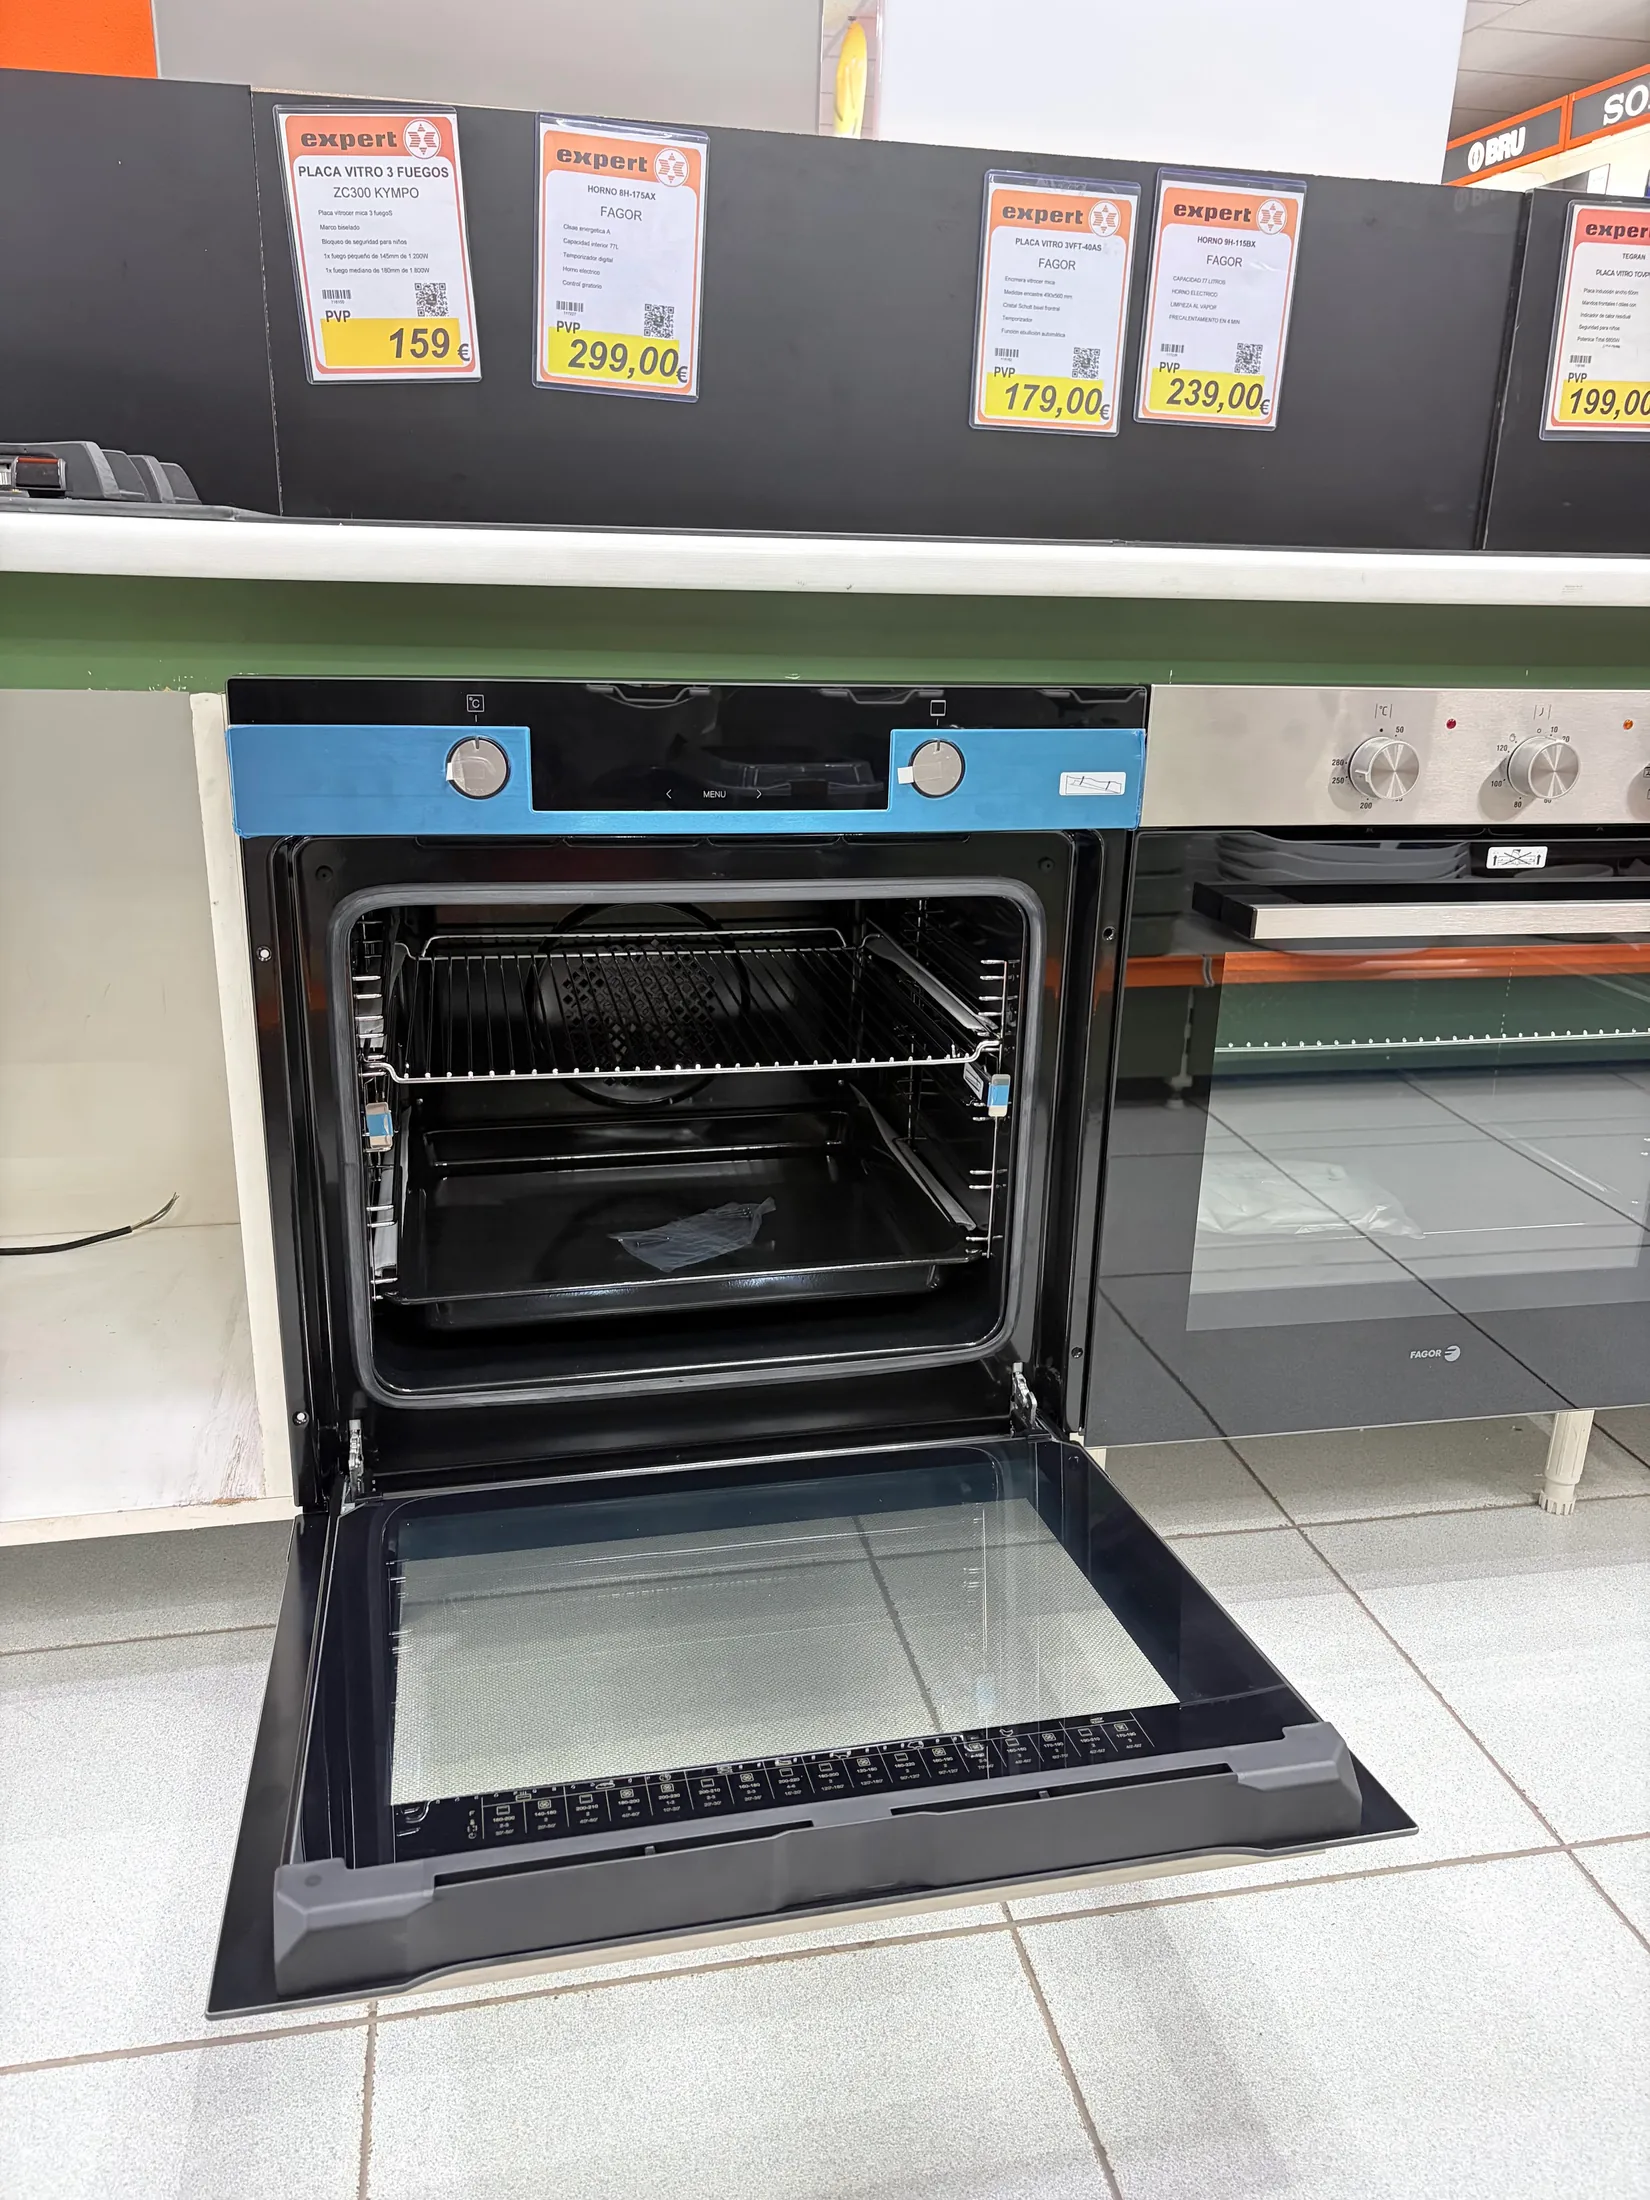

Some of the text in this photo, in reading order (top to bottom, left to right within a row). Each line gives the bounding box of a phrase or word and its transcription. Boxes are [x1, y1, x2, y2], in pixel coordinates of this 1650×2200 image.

[1603, 84, 1650, 126] SO
[301, 131, 397, 150] expert
[557, 148, 648, 172] expert
[298, 166, 449, 179] PLACA VITRO 3 FUEGOS
[333, 187, 420, 199] ZC300 KYMPO
[588, 185, 656, 200] HORNO 8H-175AX
[600, 206, 642, 221] FAGOR
[1002, 205, 1084, 225] expert
[1173, 203, 1251, 223] expert
[1585, 223, 1650, 239] exper
[1015, 238, 1102, 251] PLACA VITRO 3VFT-40AS
[1197, 236, 1223, 245] HORNO
[1038, 258, 1076, 270] FAGOR
[1206, 255, 1243, 267] FAGOR
[325, 310, 351, 322] PVP
[557, 320, 581, 334] PVP
[390, 328, 450, 358] 159
[994, 366, 1015, 378] PVP
[1159, 361, 1180, 373] PVP
[1568, 372, 1587, 383] PVP
[703, 790, 727, 798] MENU
[1410, 1349, 1442, 1359] FAGOR
